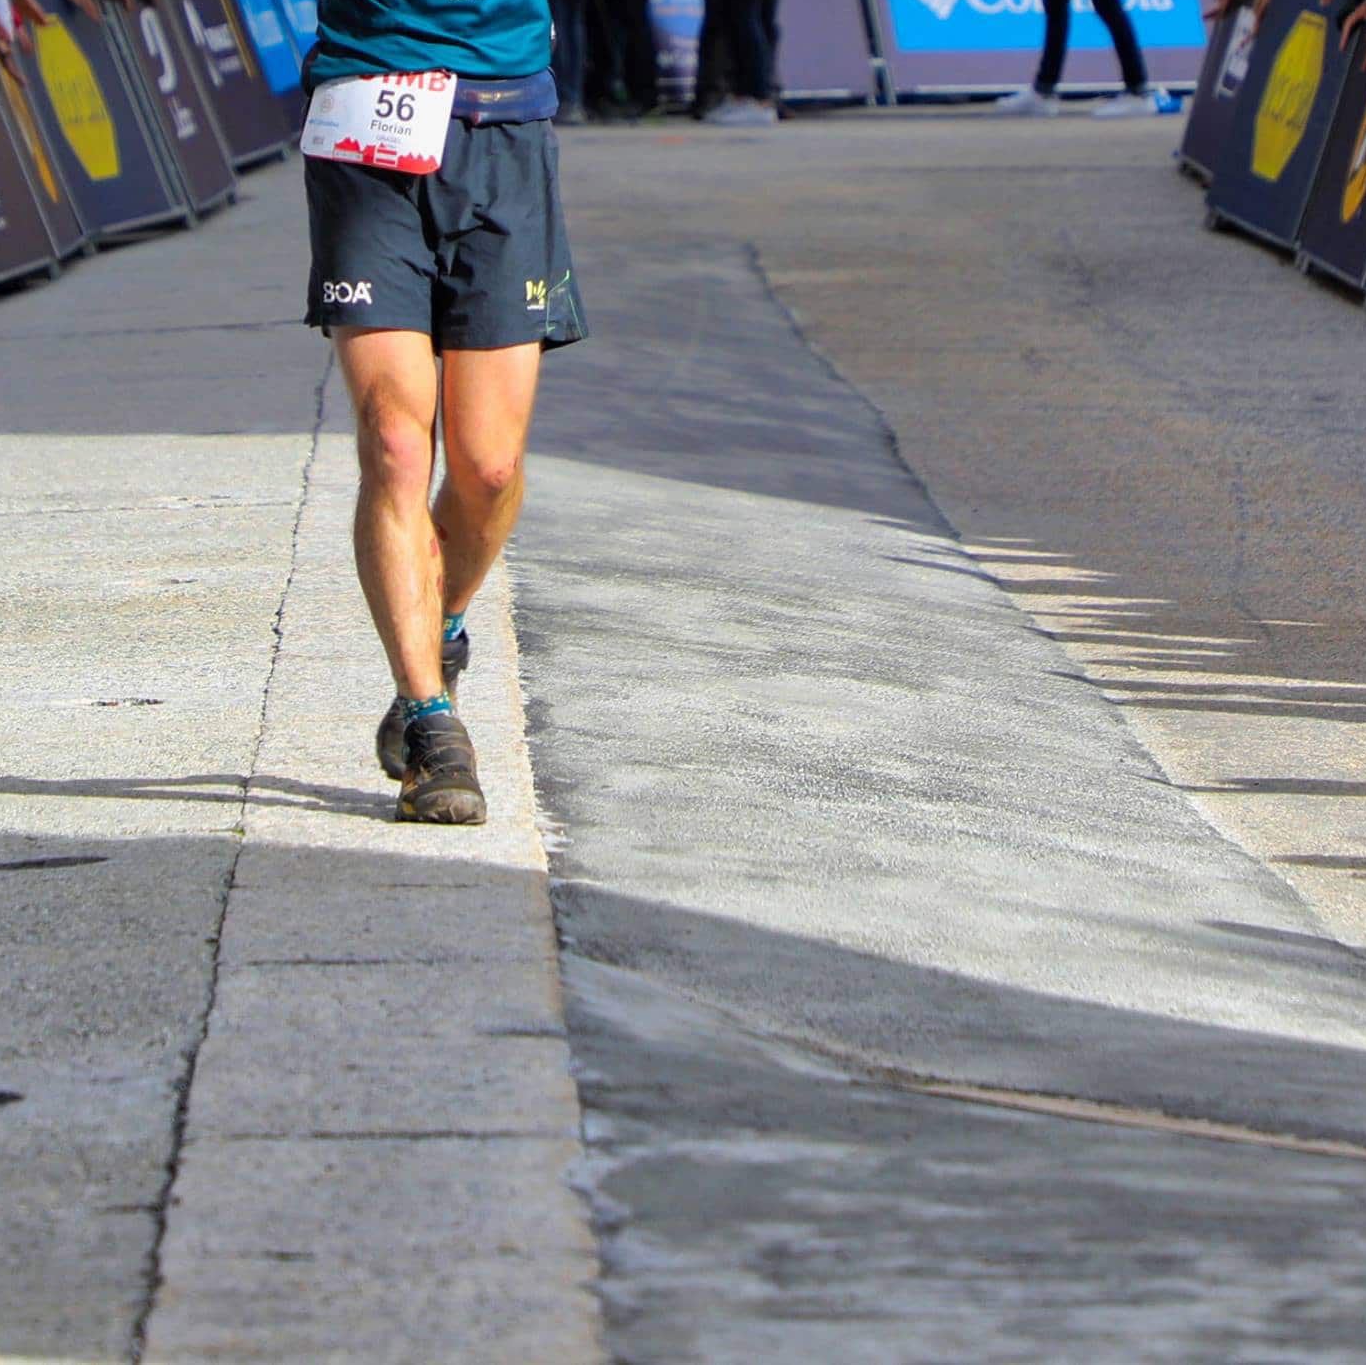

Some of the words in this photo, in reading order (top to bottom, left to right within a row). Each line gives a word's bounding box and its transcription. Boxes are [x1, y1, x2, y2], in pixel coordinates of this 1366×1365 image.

[374, 89, 416, 122] 56
[369, 119, 412, 136] Florian
[323, 281, 372, 305] BOA
